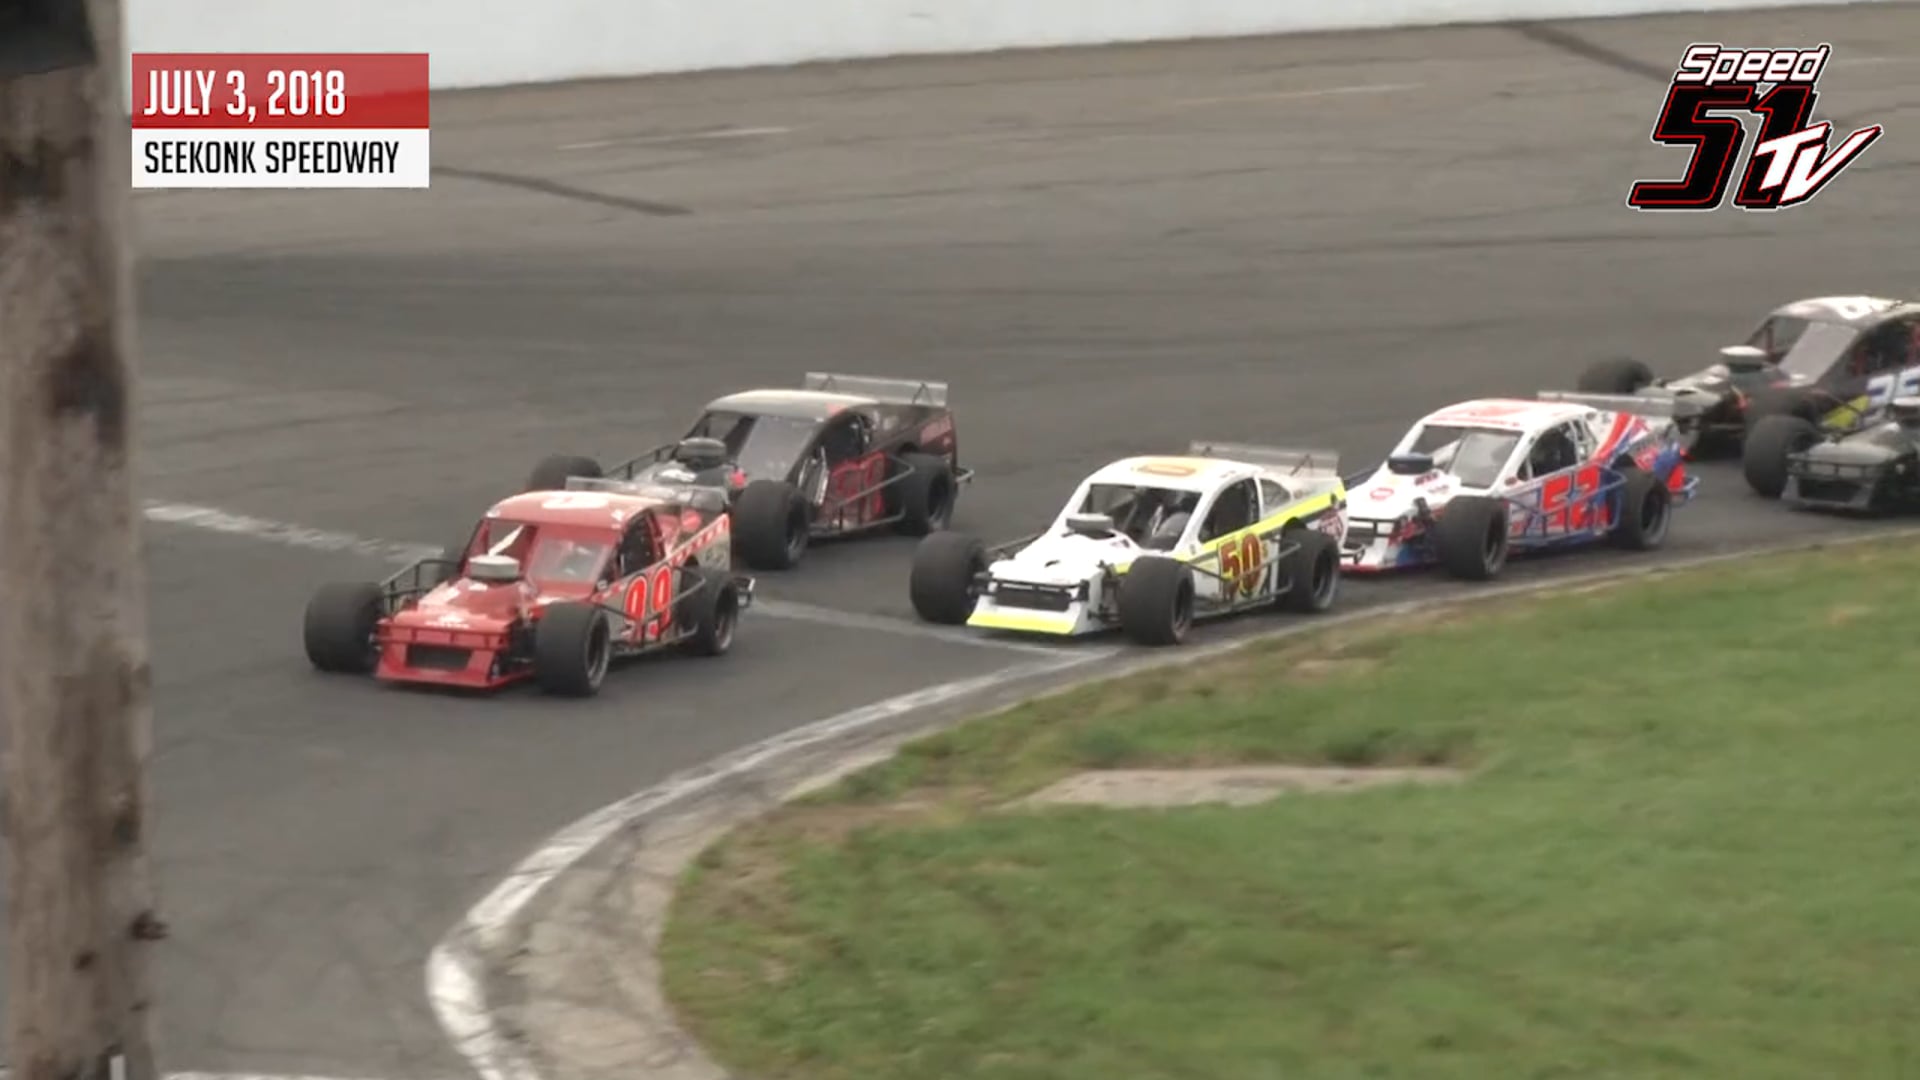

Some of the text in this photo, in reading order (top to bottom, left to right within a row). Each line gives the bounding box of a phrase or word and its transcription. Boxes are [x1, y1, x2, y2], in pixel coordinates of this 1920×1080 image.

[1541, 463, 1613, 531] 52
[1219, 532, 1262, 598] 50
[620, 564, 672, 646] 99
